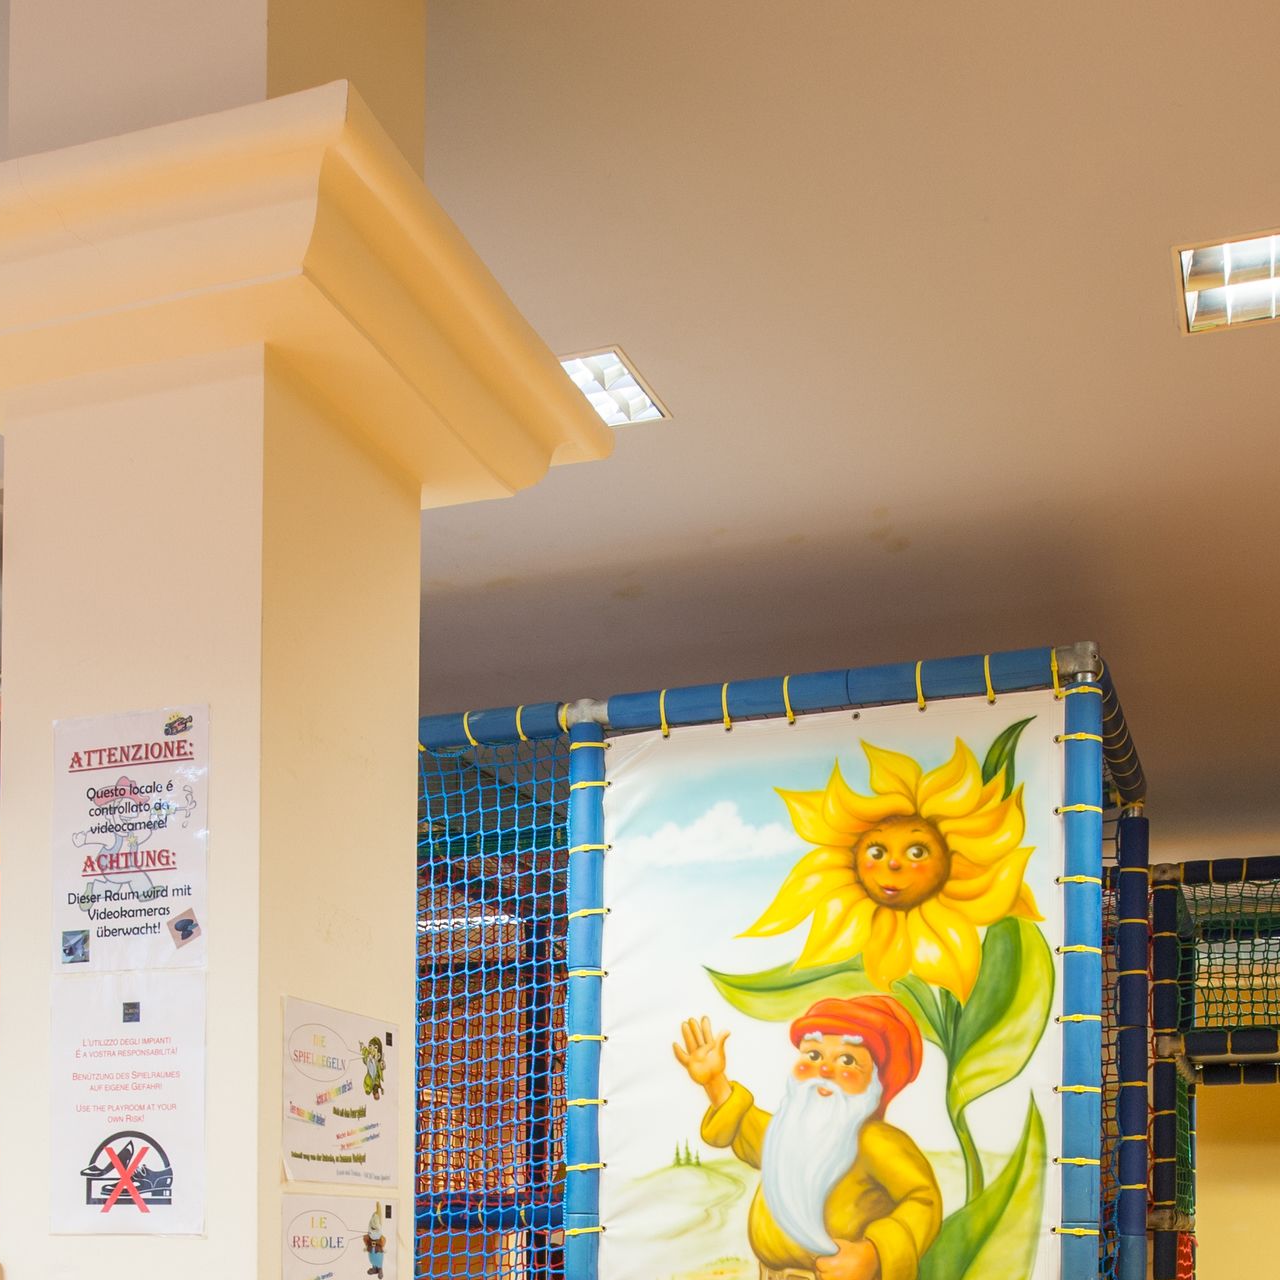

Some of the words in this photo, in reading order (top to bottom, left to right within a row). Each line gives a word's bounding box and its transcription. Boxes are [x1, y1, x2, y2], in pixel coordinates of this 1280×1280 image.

[69, 739, 194, 770] ATTENZIONE:
[86, 787, 126, 802] Questo
[129, 781, 163, 796] locale
[88, 801, 151, 817] controllato
[153, 799, 170, 811] da
[90, 815, 168, 835] videocamere!
[82, 848, 177, 873] ACHTUNG:
[67, 892, 102, 905] Dieser
[104, 889, 140, 902] Raum
[142, 885, 169, 899] wird
[171, 884, 192, 897] mit
[87, 906, 171, 921] Videokameras
[96, 921, 161, 938] überwacht!
[292, 1235, 345, 1249] REGOLE
